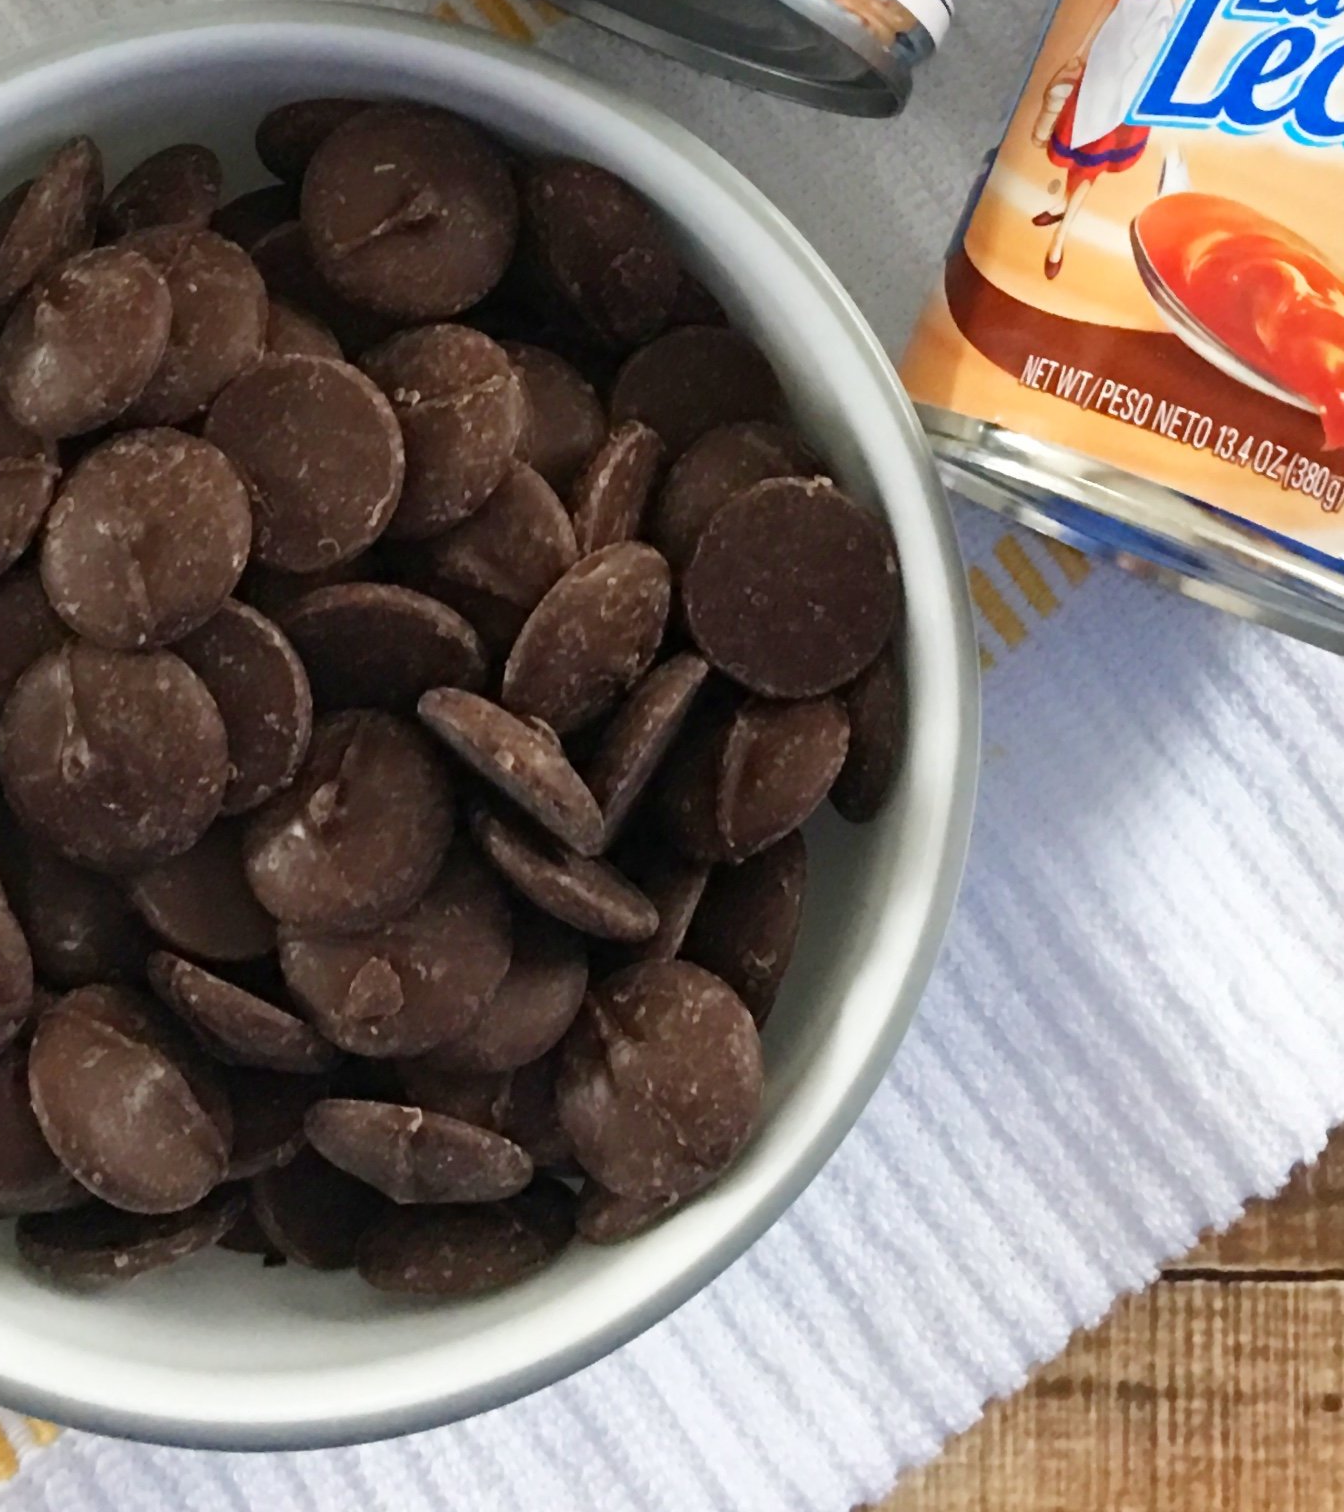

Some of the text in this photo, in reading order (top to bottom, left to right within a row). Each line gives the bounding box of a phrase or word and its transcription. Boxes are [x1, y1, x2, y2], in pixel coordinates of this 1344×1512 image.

[1018, 354, 1060, 390] NET
[1151, 399, 1213, 450] NETO
[1213, 424, 1255, 467] 13.4
[1253, 439, 1288, 480] OZ
